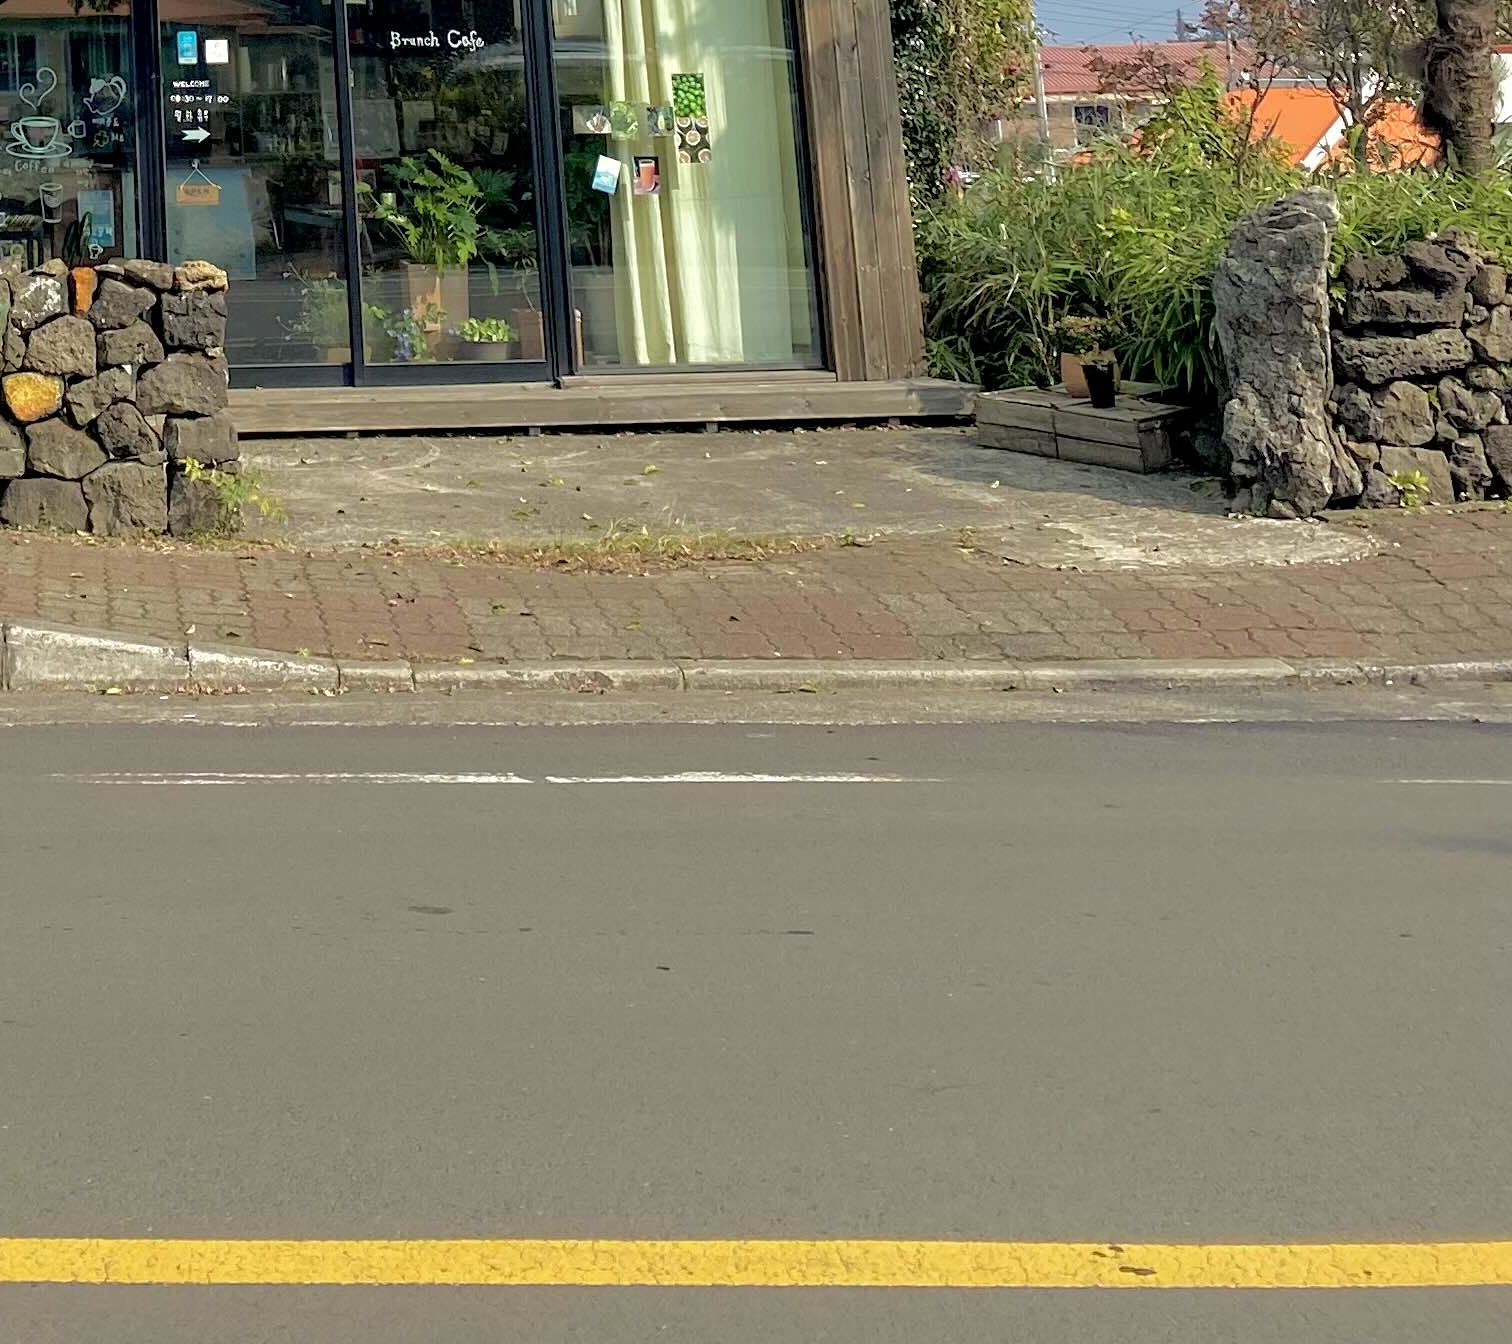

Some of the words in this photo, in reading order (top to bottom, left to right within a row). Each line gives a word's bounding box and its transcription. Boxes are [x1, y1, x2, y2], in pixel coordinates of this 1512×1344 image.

[390, 30, 440, 50] Brunch
[447, 29, 485, 52] Cafe
[172, 80, 210, 88] WELCOME
